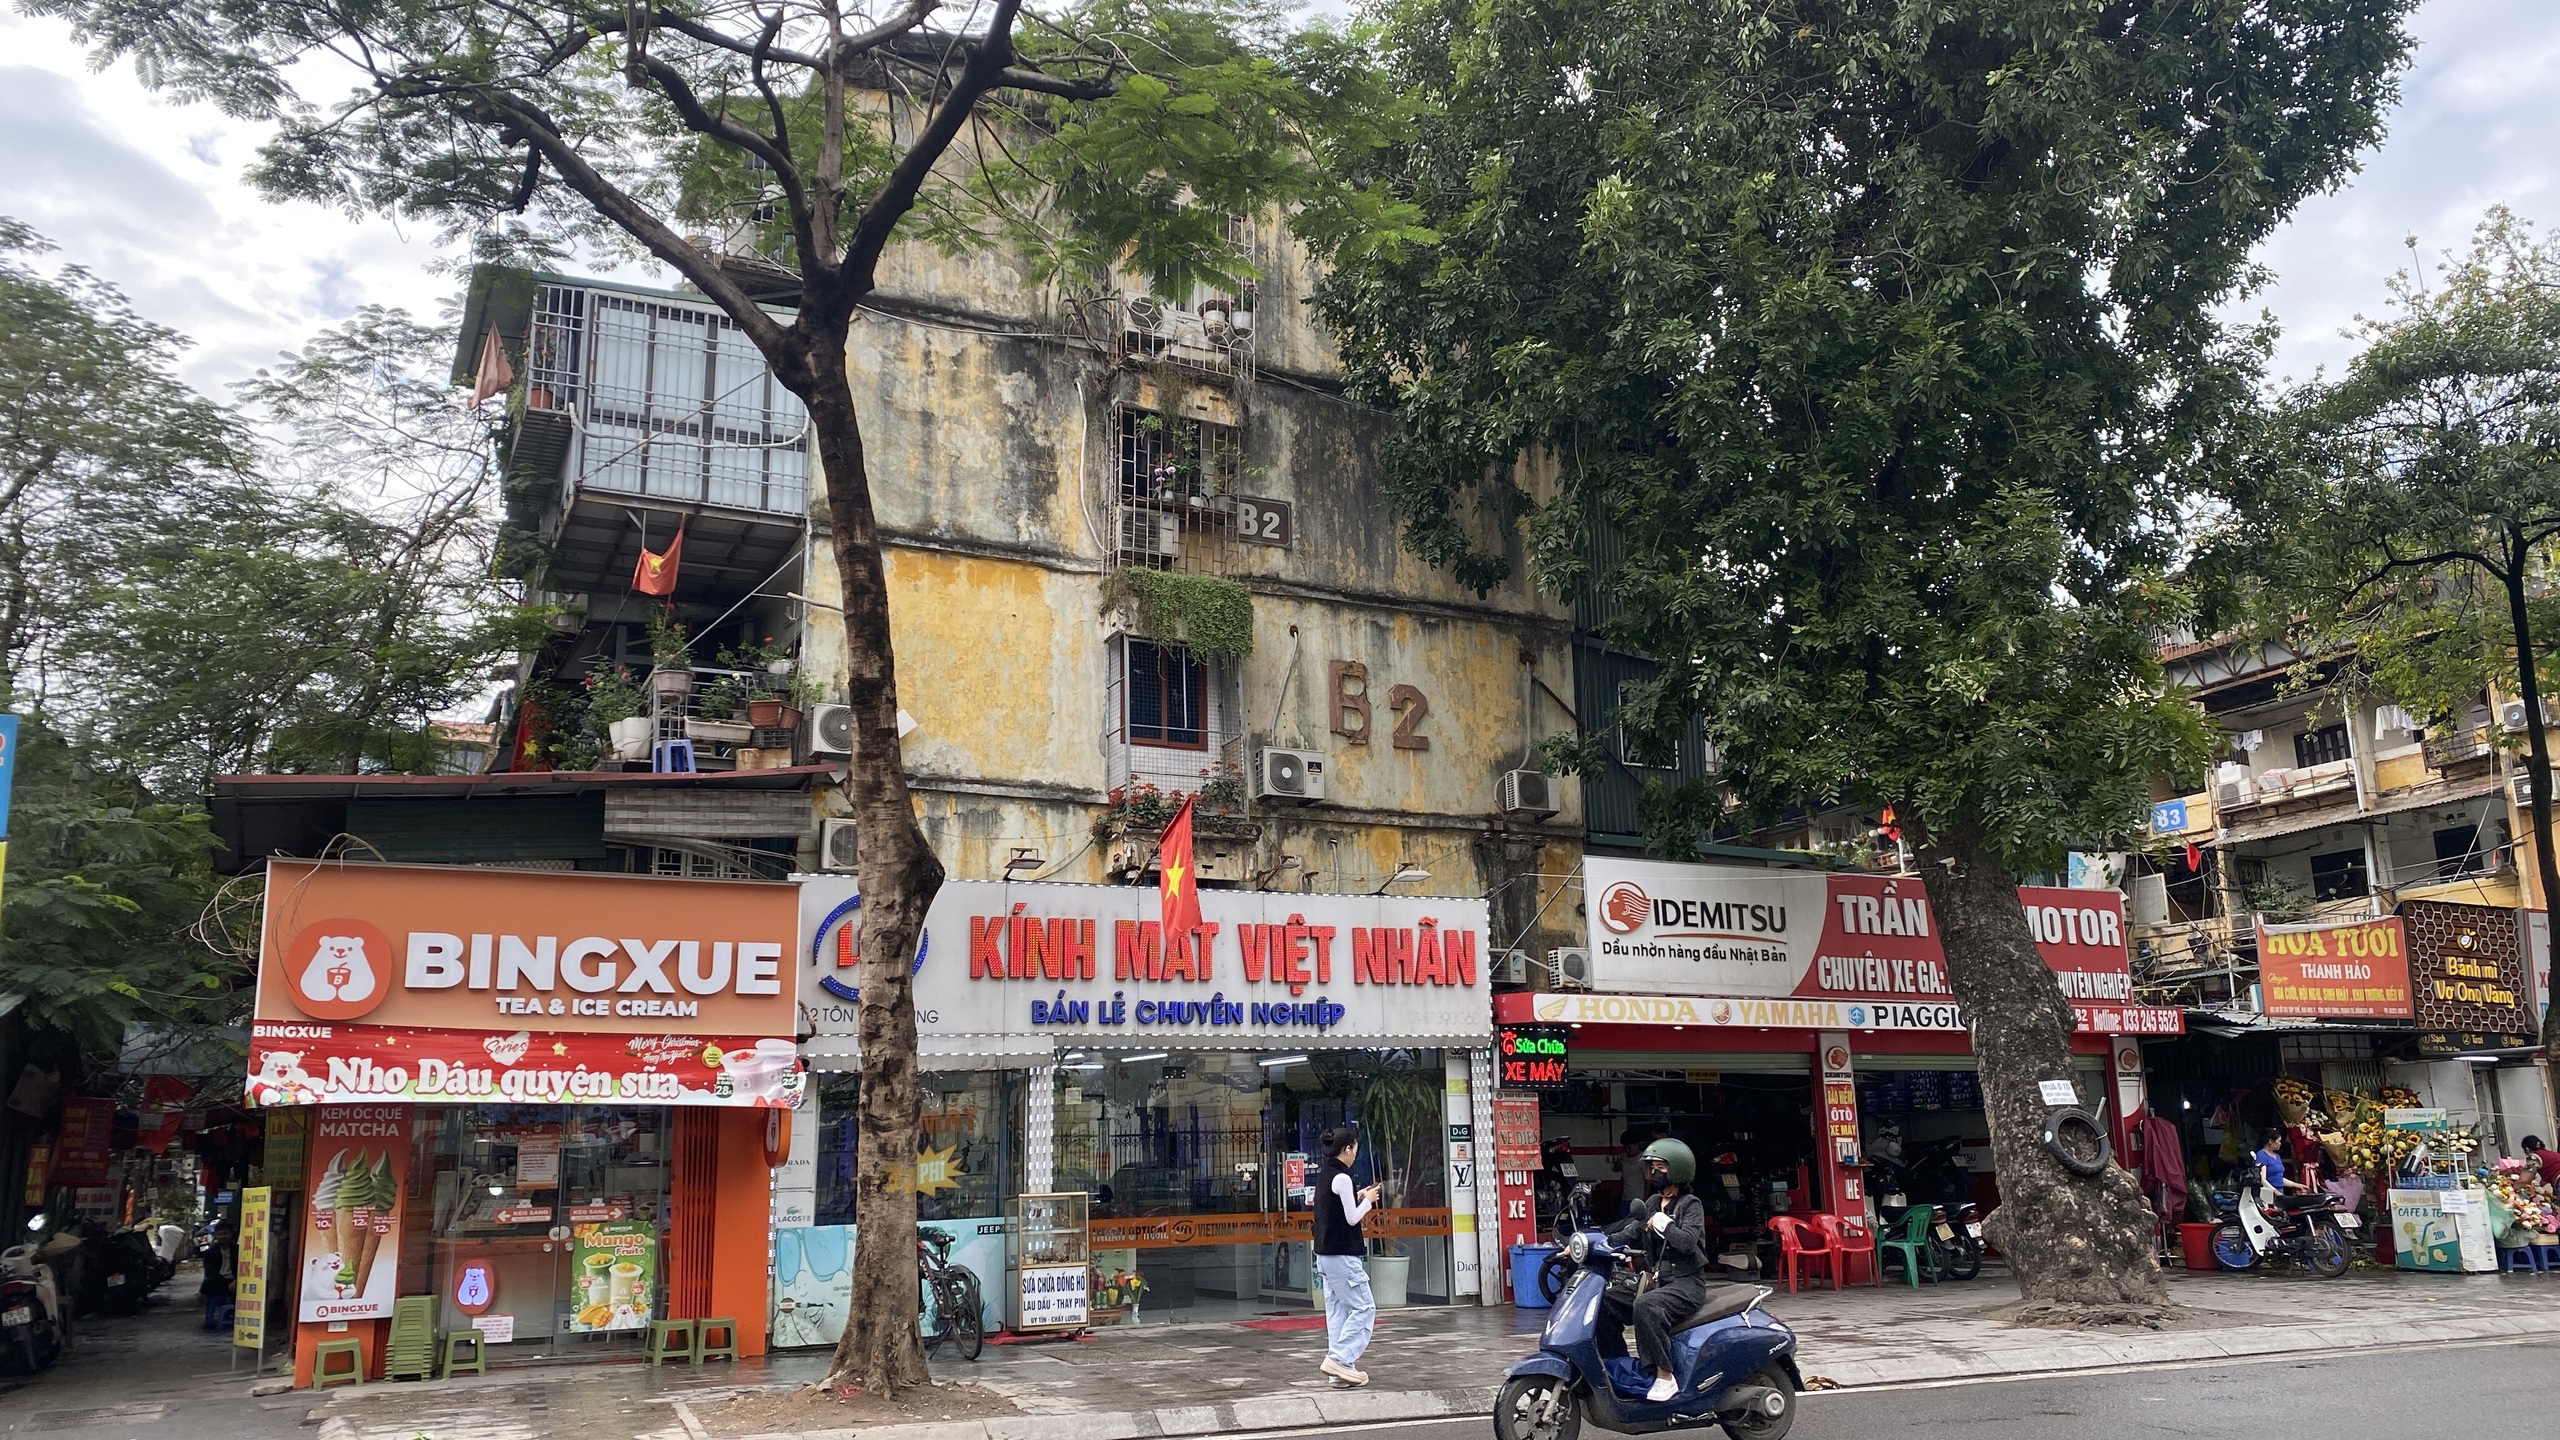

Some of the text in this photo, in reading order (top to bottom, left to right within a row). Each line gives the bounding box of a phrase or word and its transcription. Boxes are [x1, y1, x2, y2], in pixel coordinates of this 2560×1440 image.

[1240, 503, 1280, 539] B2
[1330, 660, 1429, 750] B2
[1653, 898, 1787, 934] IDEMITSU
[1836, 880, 2121, 947] TRẦN MOTOR
[969, 902, 1477, 997] KÍNH VIỆT NHÃN
[2267, 924, 2398, 958] HOA TƯƠI
[1602, 937, 1787, 966] Dầu nhờn hàng đầu Nhật Bản
[404, 931, 782, 996] BINGXUE
[2300, 960, 2371, 980] THANH HẢO
[2445, 956, 2498, 979] Bánh mì
[1817, 950, 1888, 994] CHUYÊN
[1891, 959, 1915, 994] XE
[1917, 960, 1944, 995] GA:
[2092, 968, 2131, 1004] NGHIỆP
[2434, 980, 2454, 1004] Vợ
[2455, 982, 2483, 1007] Ong
[2480, 983, 2515, 1009] Vàng
[496, 996, 699, 1019] TEA & ICE CREAM
[822, 1005, 854, 1021] TÔN
[1032, 989, 1346, 1032] BÁN LẺ CHUYÊN NGHIỆP
[1576, 998, 1701, 1024] HONDA
[1732, 1002, 1841, 1027] YAMAHA
[2093, 1009, 2121, 1032] Hotline:
[2123, 1009, 2139, 1032] 033
[2140, 1010, 2157, 1032] 245
[2158, 1010, 2179, 1032] 5523
[253, 1025, 332, 1039] BINGXUE
[484, 1039, 527, 1056] Series
[627, 1034, 703, 1051] Merry Christmas
[324, 1057, 409, 1094] Nho
[414, 1060, 495, 1095] Dâu
[501, 1064, 620, 1102] quyện
[1504, 1058, 1565, 1082] XE MÁY
[321, 1108, 350, 1120] KEM
[354, 1106, 372, 1120] ỐC
[375, 1106, 402, 1121] QUẾ
[1498, 1110, 1512, 1125] XE
[1831, 1107, 1853, 1122] ÔTÔ
[319, 1122, 399, 1137] MATCHA
[1452, 1127, 1468, 1136] D&G
[1499, 1130, 1513, 1145] XE
[1829, 1122, 1856, 1136] XE MÁY
[919, 1153, 945, 1184] PHÍ
[1234, 1163, 1258, 1171] OPEN
[777, 1215, 811, 1223] LACOSTE
[1508, 1200, 1526, 1219] XE
[2398, 1207, 2421, 1217] CAFE
[2422, 1208, 2429, 1217] &
[978, 1225, 1000, 1234] JEEP
[584, 1232, 645, 1248] Mango
[615, 1247, 645, 1256] Fruits
[1457, 1261, 1479, 1273] Dior
[1022, 1271, 1036, 1294] SỬA
[1037, 1273, 1055, 1293] CHỮA
[330, 1304, 379, 1314] BINGXUE
[1023, 1300, 1036, 1311] LAU
[1057, 1298, 1073, 1309] THAY
[1074, 1297, 1086, 1308] PIN
